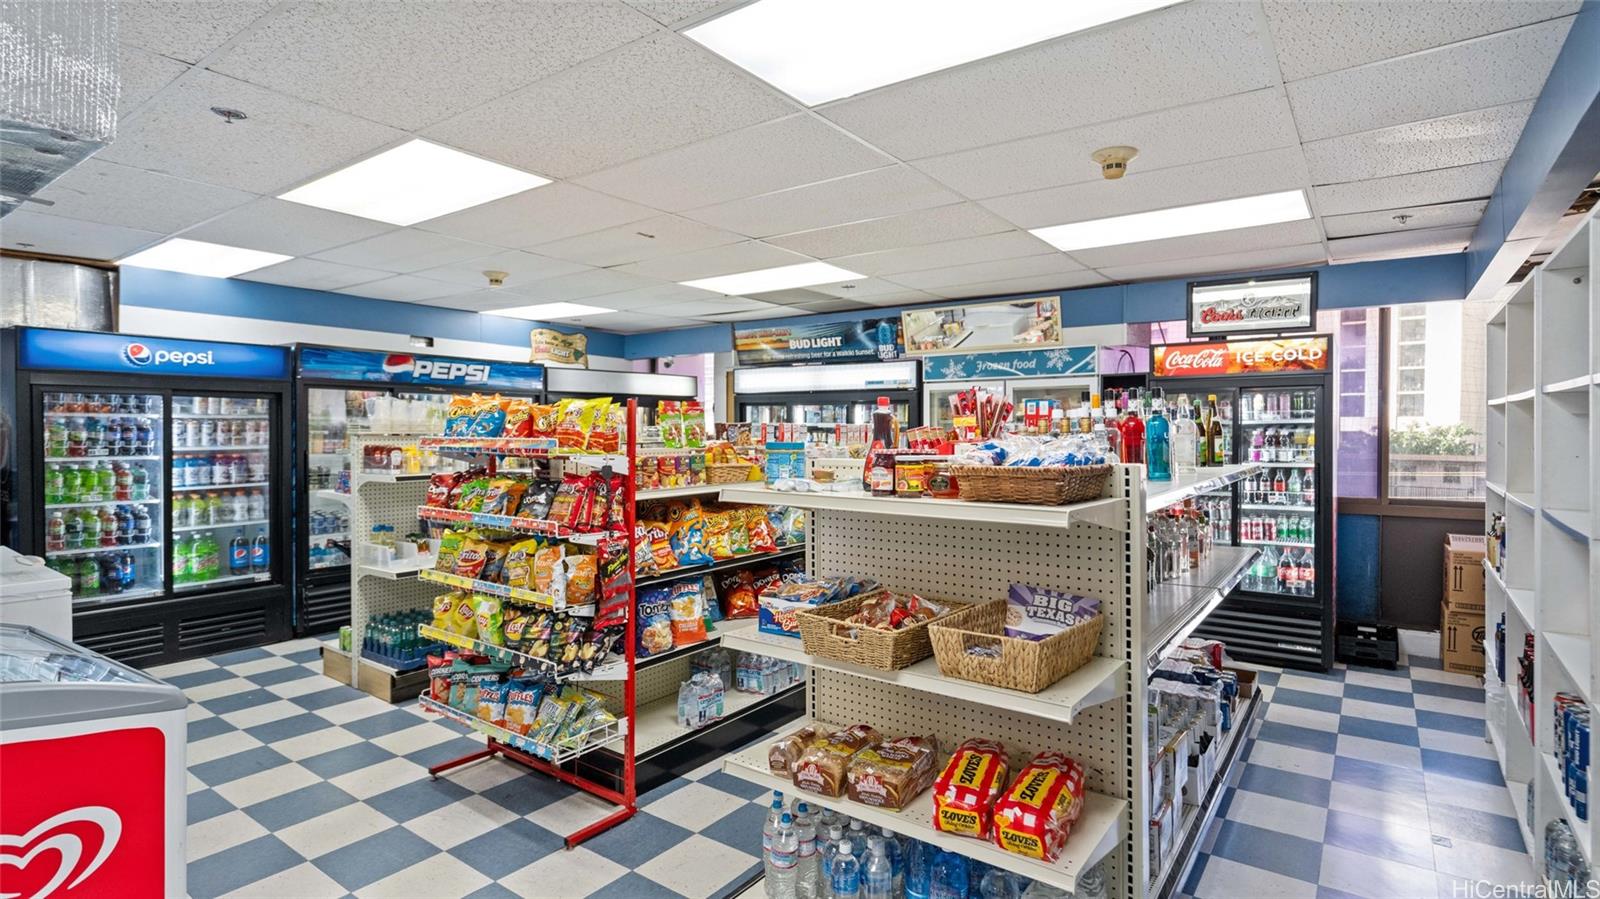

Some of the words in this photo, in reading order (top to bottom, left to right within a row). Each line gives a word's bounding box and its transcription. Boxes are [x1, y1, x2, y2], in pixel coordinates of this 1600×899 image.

[788, 338, 811, 350] BUD
[811, 336, 842, 349] LIGHT
[878, 344, 895, 352] BUD
[154, 350, 214, 367] pepsi
[878, 351, 898, 360] LIGHT
[1235, 351, 1265, 365] ICE
[1271, 348, 1322, 362] COLD
[413, 360, 491, 382] PEPSI
[975, 360, 1010, 373] Frozen
[1012, 358, 1037, 370] food
[1033, 594, 1073, 613] BIG
[1026, 605, 1076, 627] TEXAS
